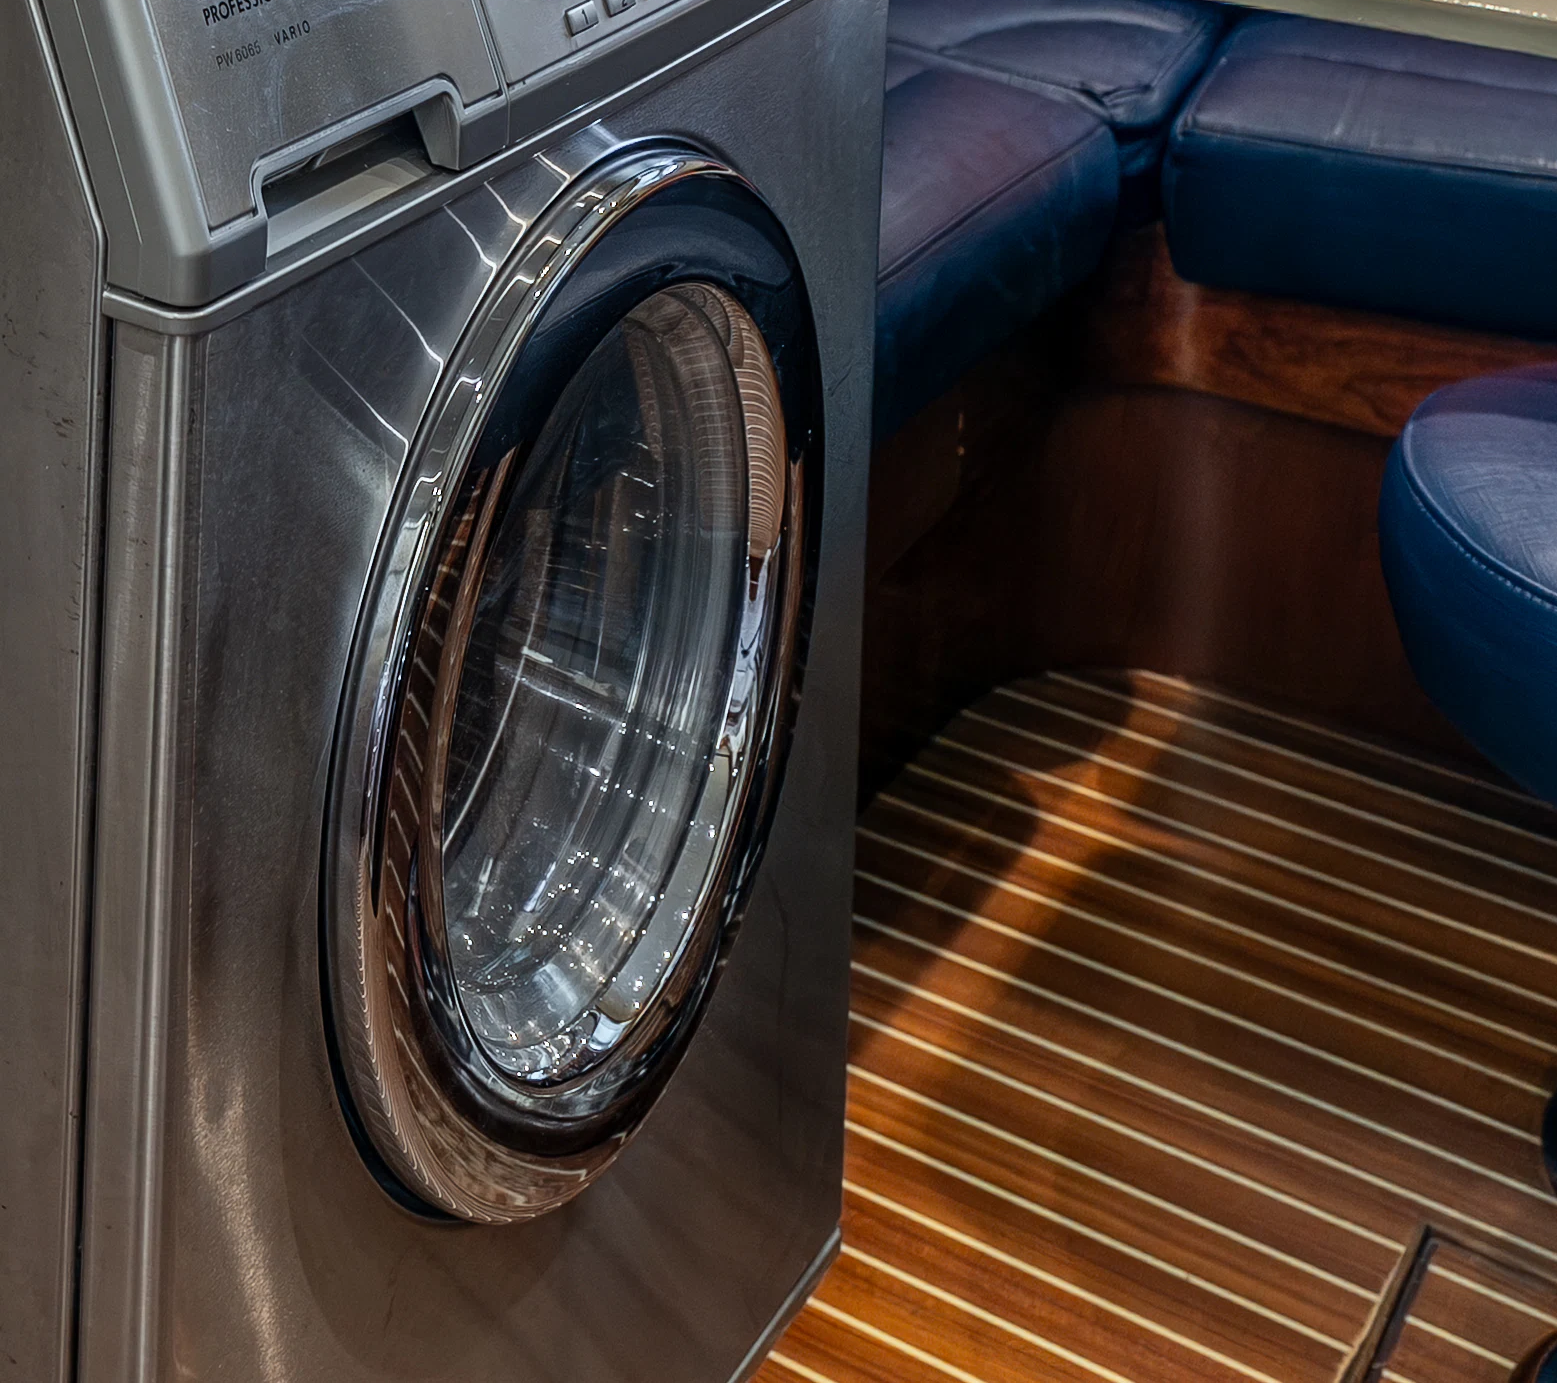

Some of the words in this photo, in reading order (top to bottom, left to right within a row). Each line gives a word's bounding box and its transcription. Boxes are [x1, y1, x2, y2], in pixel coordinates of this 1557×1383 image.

[581, 8, 589, 25] 1
[235, 39, 262, 63] 6065
[273, 19, 311, 45] VARIO
